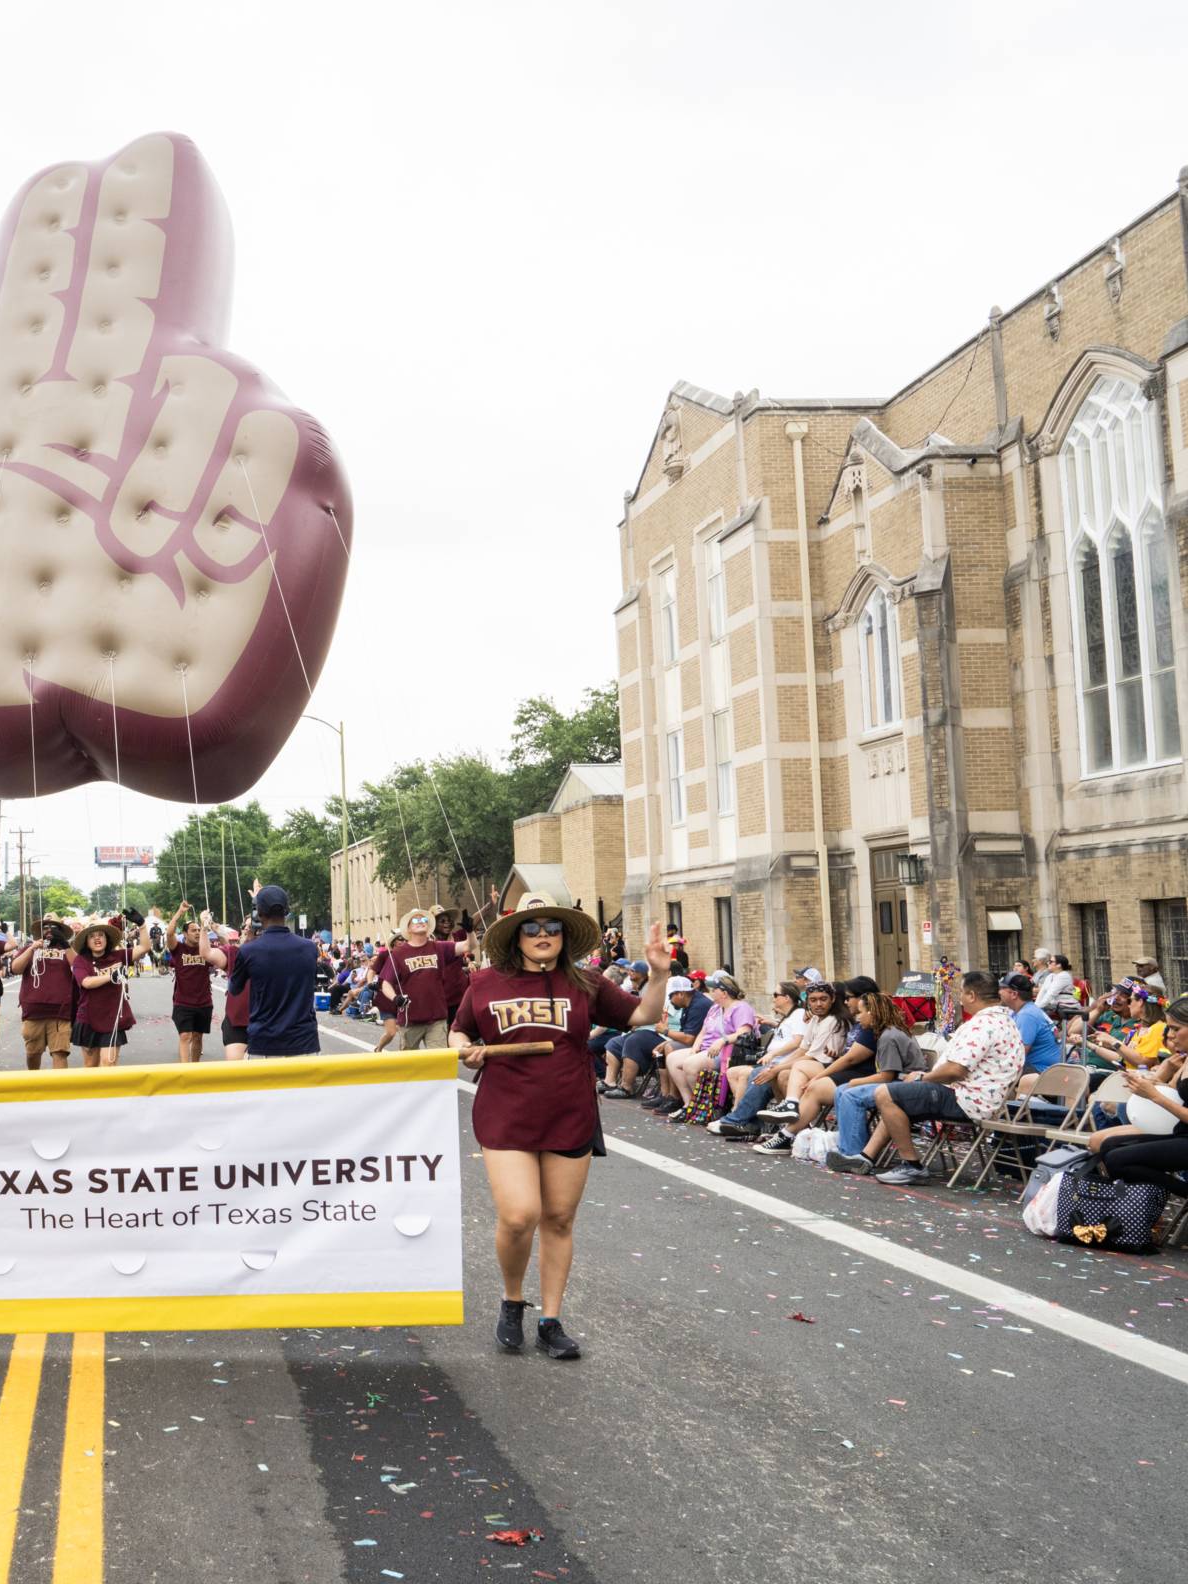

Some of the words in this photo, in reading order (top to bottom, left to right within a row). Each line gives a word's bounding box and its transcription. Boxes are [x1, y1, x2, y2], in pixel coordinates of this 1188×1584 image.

[406, 955, 437, 971] TXST
[492, 1000, 569, 1031] TXST
[88, 1166, 199, 1194] STATE
[214, 1154, 444, 1190] UNIVERSITY
[20, 1207, 74, 1229] The
[84, 1206, 164, 1228] Heart
[172, 1204, 200, 1226] of
[208, 1203, 292, 1225] Texas
[302, 1199, 377, 1222] State
